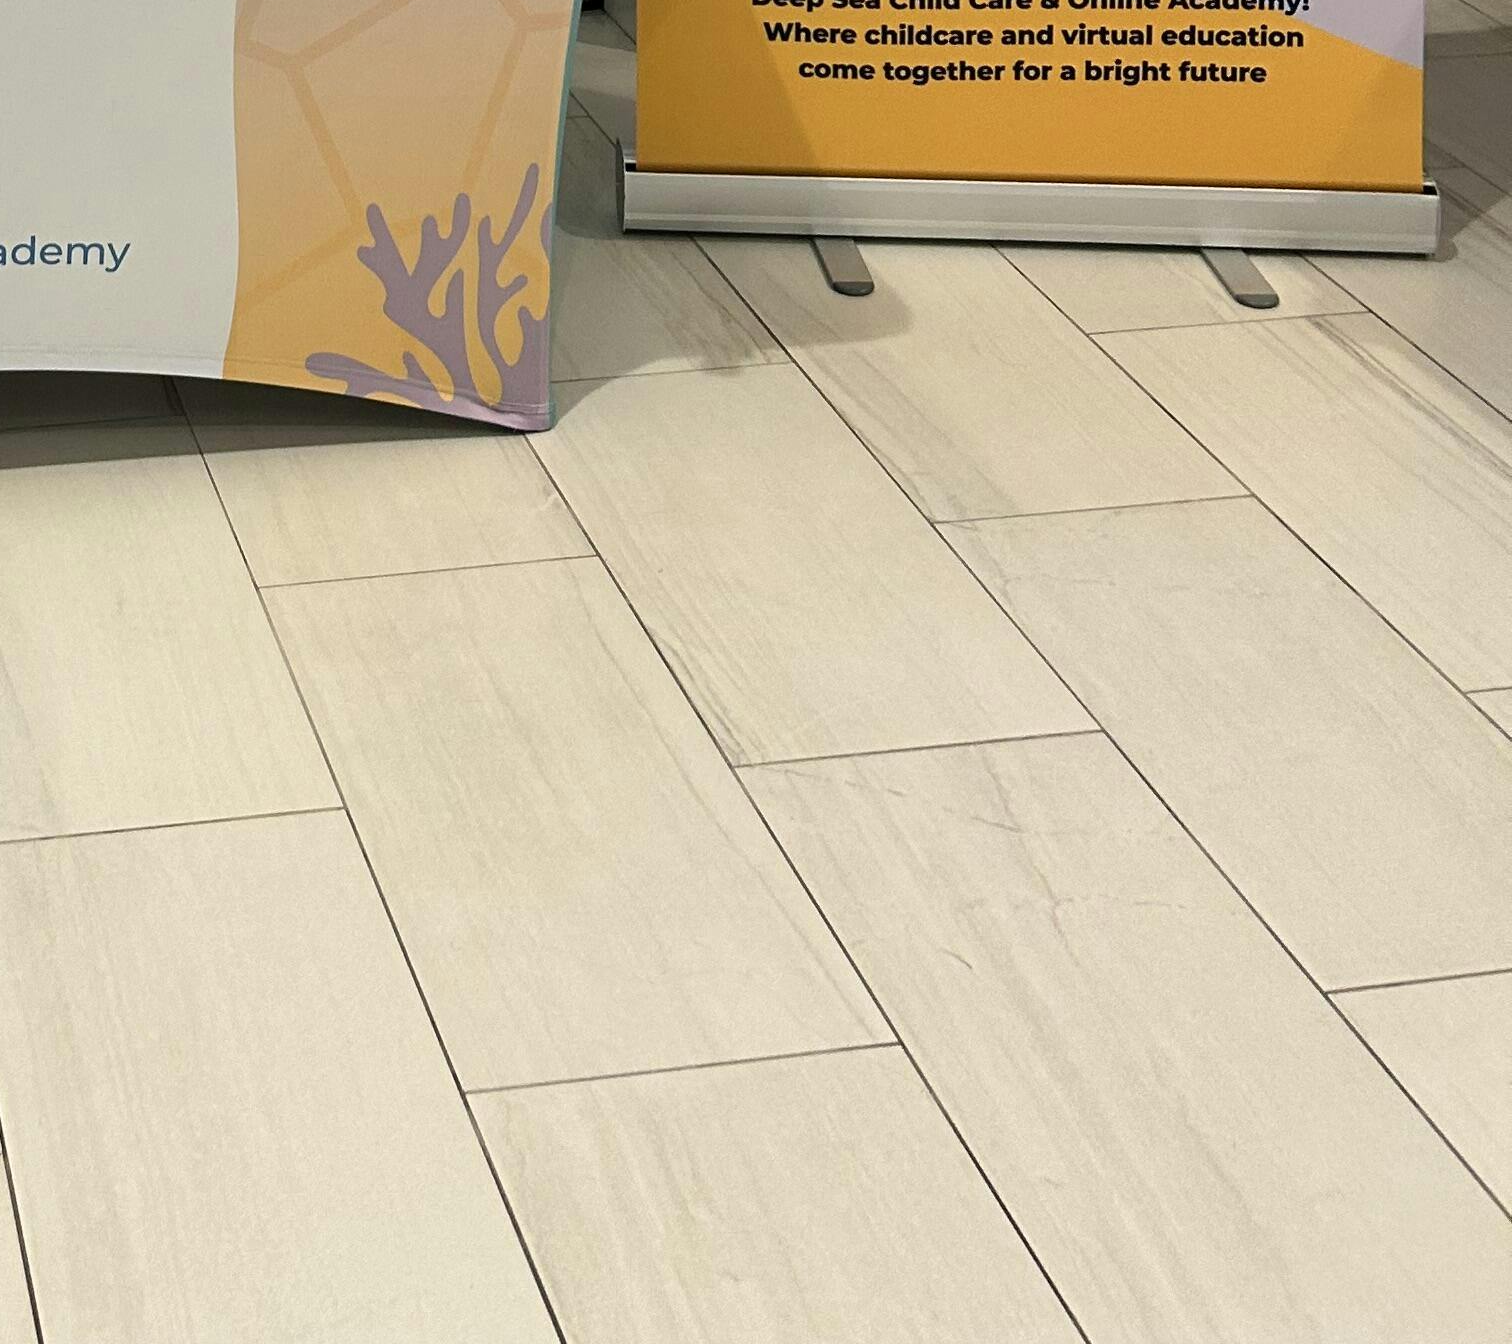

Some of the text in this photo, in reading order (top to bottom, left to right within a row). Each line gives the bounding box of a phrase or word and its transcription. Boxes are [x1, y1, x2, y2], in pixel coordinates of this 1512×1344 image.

[763, 23, 1304, 48] Where childcare and virtual education
[798, 59, 1267, 86] come together for a bright future
